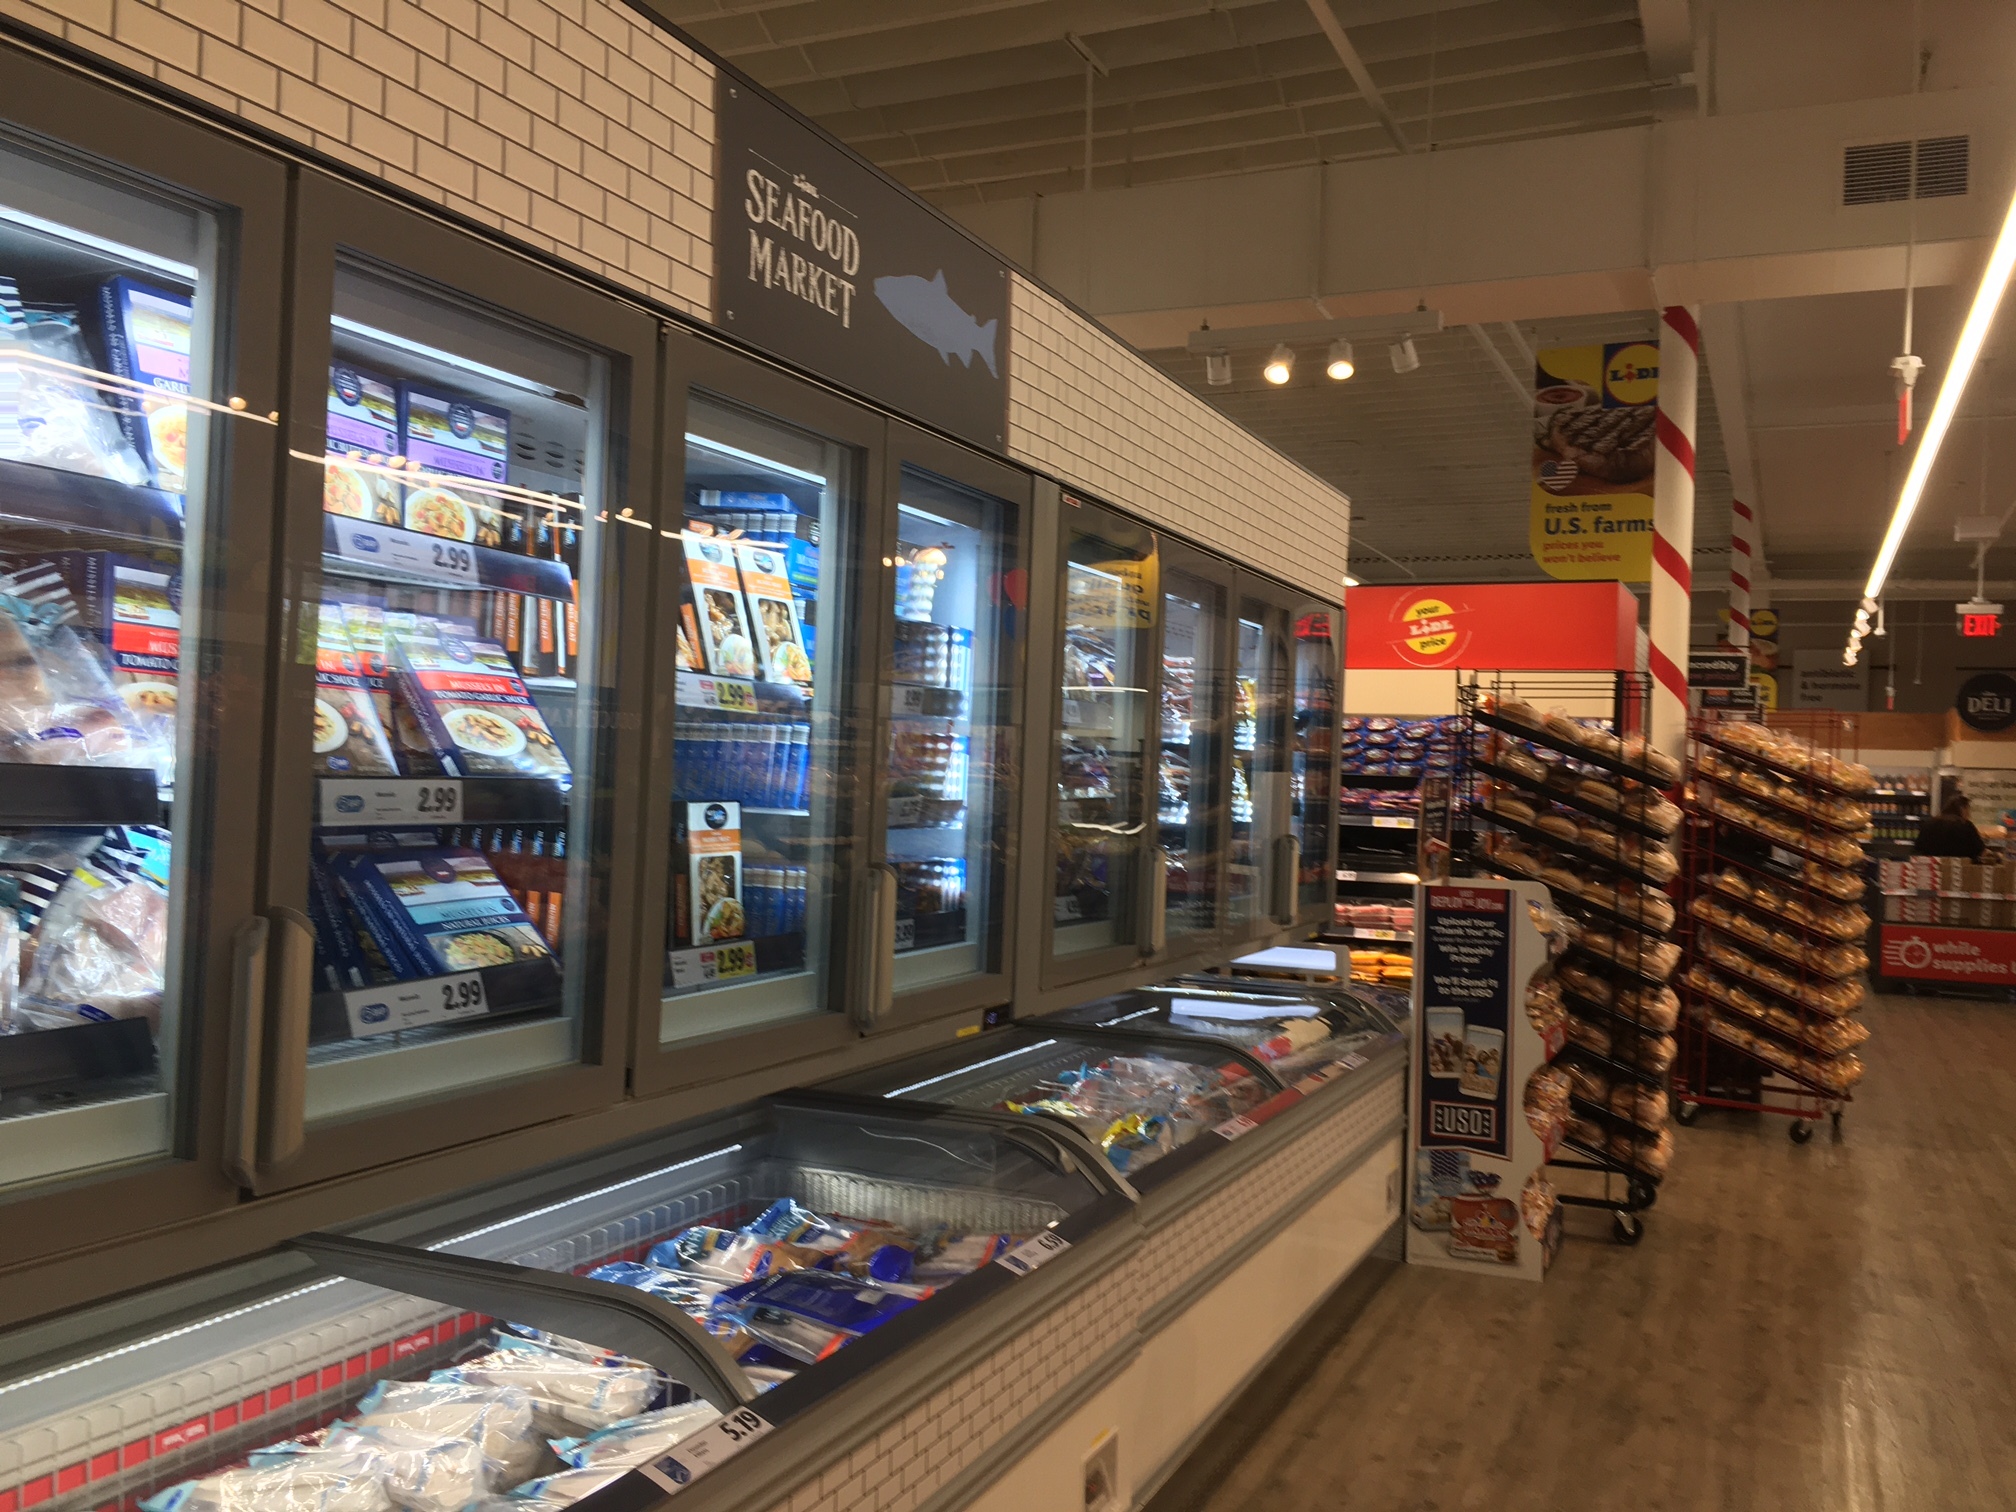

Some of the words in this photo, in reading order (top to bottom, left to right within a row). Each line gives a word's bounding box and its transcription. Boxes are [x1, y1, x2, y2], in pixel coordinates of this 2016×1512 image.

[744, 168, 860, 276] SEAFOOD
[747, 227, 856, 329] MARKET
[1546, 503, 1578, 513] fresh
[1581, 502, 1612, 512] from
[1545, 517, 1588, 535] U.S.
[1594, 516, 1655, 533] farms
[431, 544, 470, 572] 2.99
[1415, 605, 1440, 617] your
[1964, 614, 1998, 636] EXIT
[1419, 637, 1447, 651] price
[1689, 660, 1741, 672] ncredibly
[1967, 696, 2012, 713] DELI
[417, 786, 457, 813] 2.99
[1932, 940, 1982, 956] while
[1931, 958, 2009, 975] supplies
[441, 980, 481, 1010] 2.99
[1443, 1106, 1483, 1135] USO
[718, 1410, 762, 1442] 5.19
